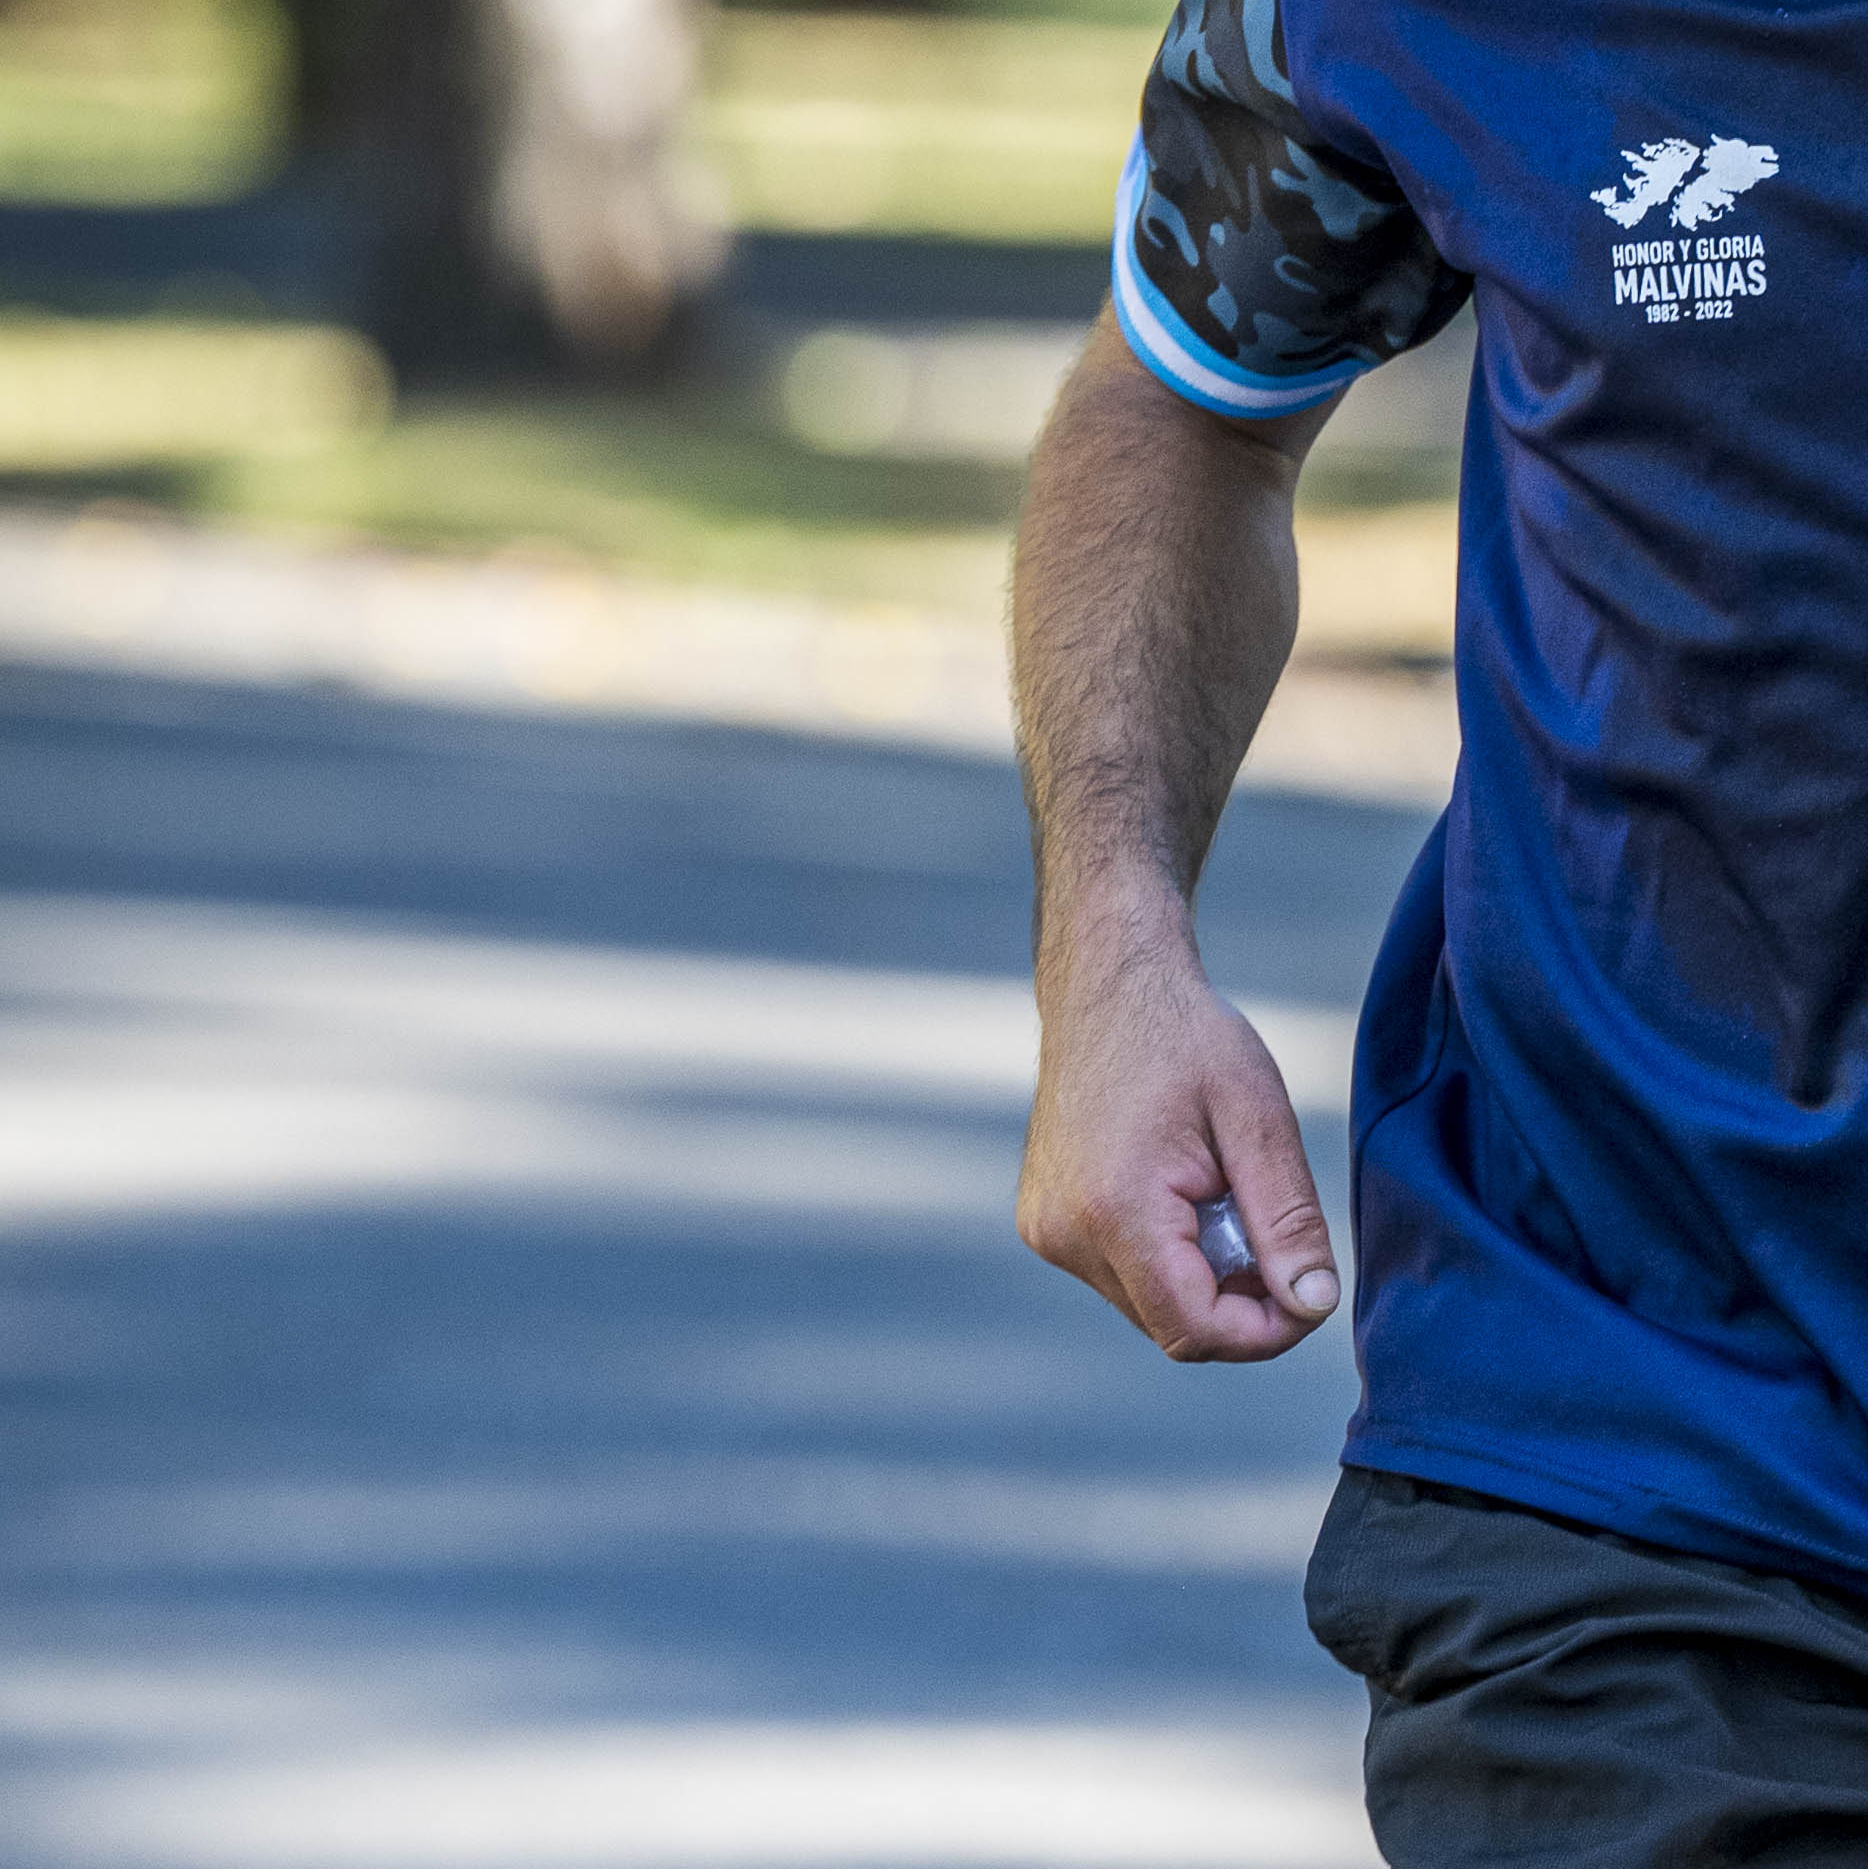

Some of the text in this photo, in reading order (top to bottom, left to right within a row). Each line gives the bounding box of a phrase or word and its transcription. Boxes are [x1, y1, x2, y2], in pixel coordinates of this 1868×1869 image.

[1612, 235, 1765, 268] HONOR Y GLORIA
[1613, 259, 1767, 305] MALVINAS
[1645, 302, 1681, 324] 1982
[1694, 300, 1734, 321] 2022
